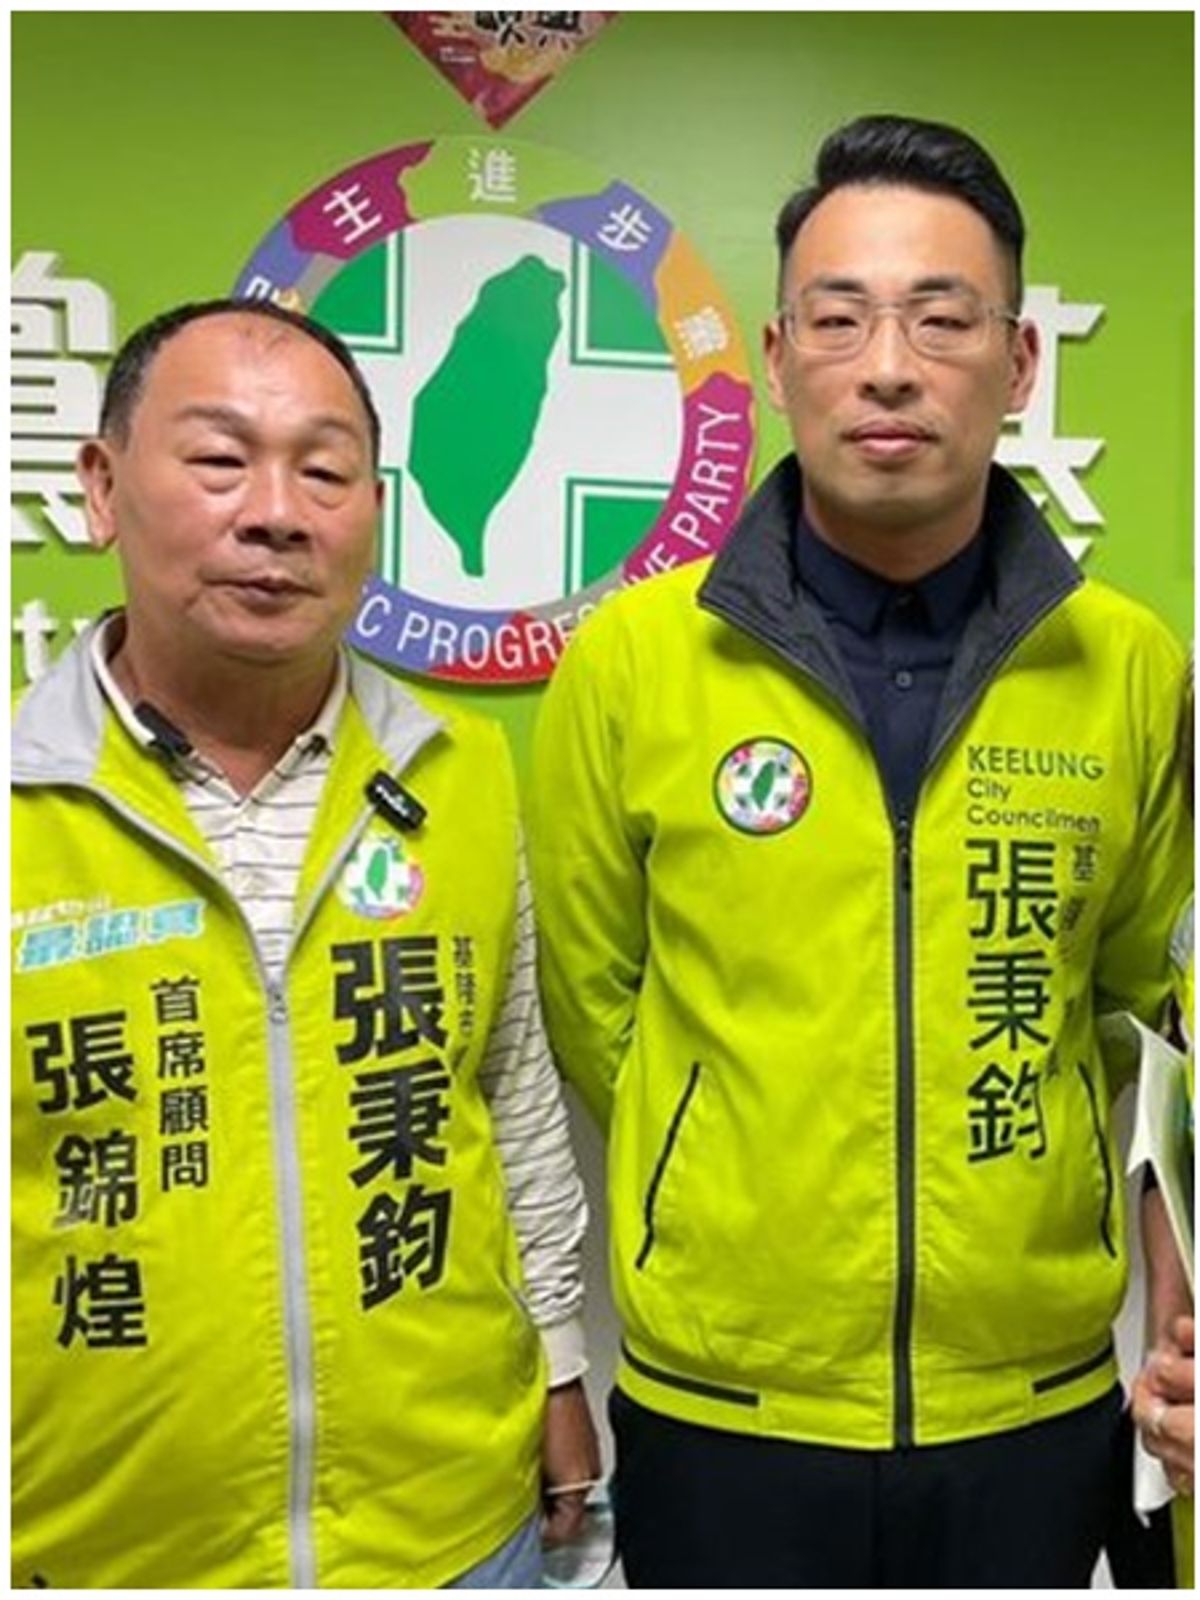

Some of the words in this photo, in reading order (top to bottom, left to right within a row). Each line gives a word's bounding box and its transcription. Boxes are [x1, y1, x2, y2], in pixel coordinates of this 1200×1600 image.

[397, 542, 678, 670] PROGREE
[670, 403, 742, 548] PARTY
[967, 745, 1104, 781] KEELUNG
[967, 777, 1012, 802] City
[150, 974, 209, 1192] 首席顧問
[330, 935, 453, 1312] 張秉鈞
[966, 838, 1058, 1165] 張秉鈞
[25, 1010, 148, 1350] 張錦煌
